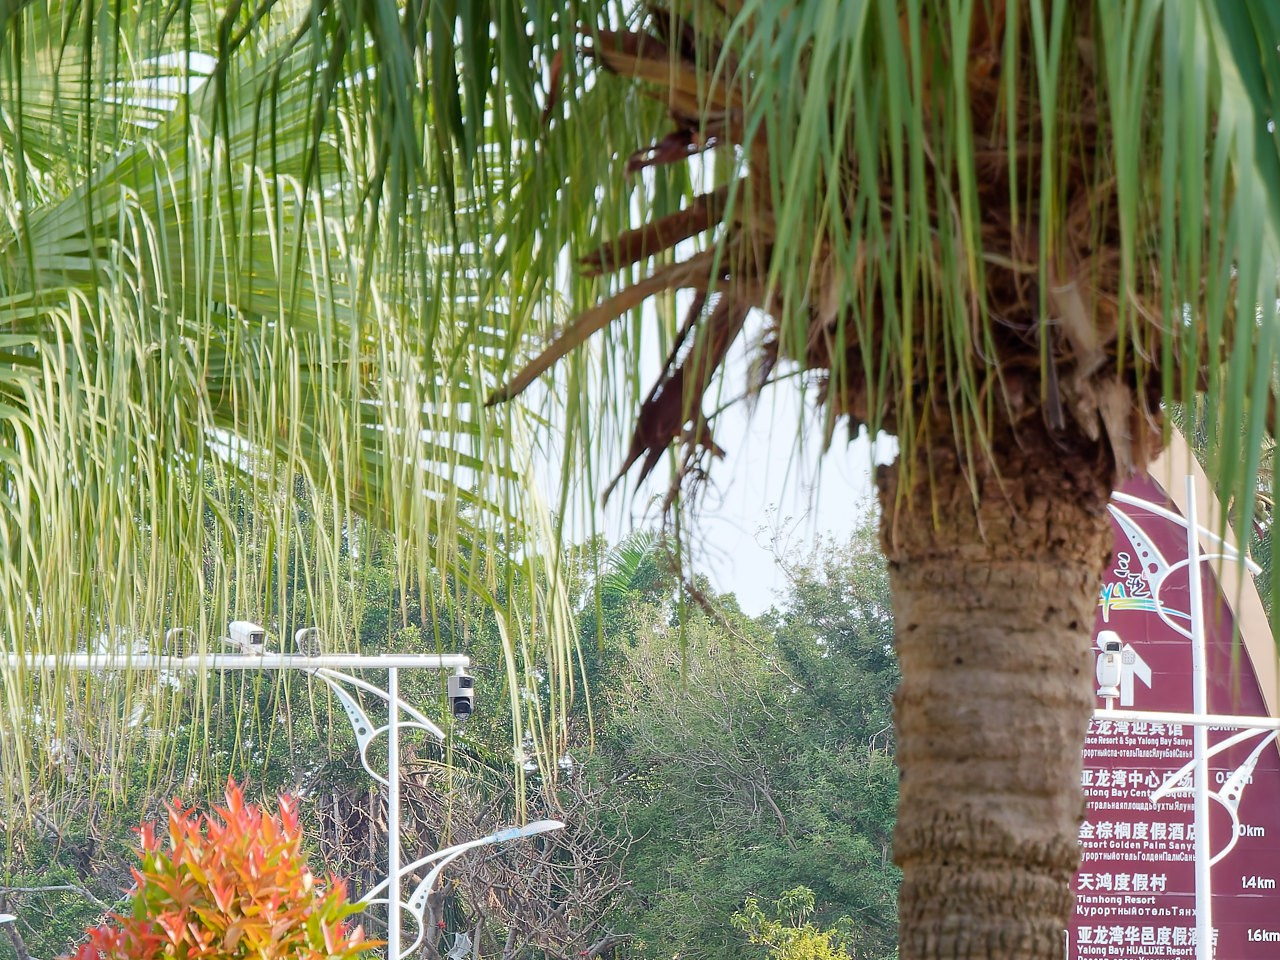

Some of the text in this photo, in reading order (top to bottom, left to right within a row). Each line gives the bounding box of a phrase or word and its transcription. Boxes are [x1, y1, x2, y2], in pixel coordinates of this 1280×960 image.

[1098, 736, 1119, 745] Resort
[1120, 737, 1124, 745] &
[1125, 737, 1136, 746] Spa
[1137, 737, 1159, 747] Yalong
[1160, 737, 1173, 747] Bay
[1173, 737, 1193, 746] Sanya
[1081, 788, 1109, 798] along
[1111, 788, 1128, 798] Bay
[1077, 821, 1197, 840] 金棕榈度假酒店
[1109, 840, 1141, 849] Golden
[1143, 841, 1166, 850] Palm
[1077, 873, 1168, 892] 天鸿度假村
[1241, 876, 1276, 889] 1.4km
[1076, 895, 1156, 905] Tianhong Resort
[1247, 929, 1280, 942] 1.6km
[1077, 945, 1107, 956] Yalong
[1108, 946, 1125, 956] Bay
[1126, 946, 1165, 955] HUALUXE
[1166, 947, 1193, 955] Resort
